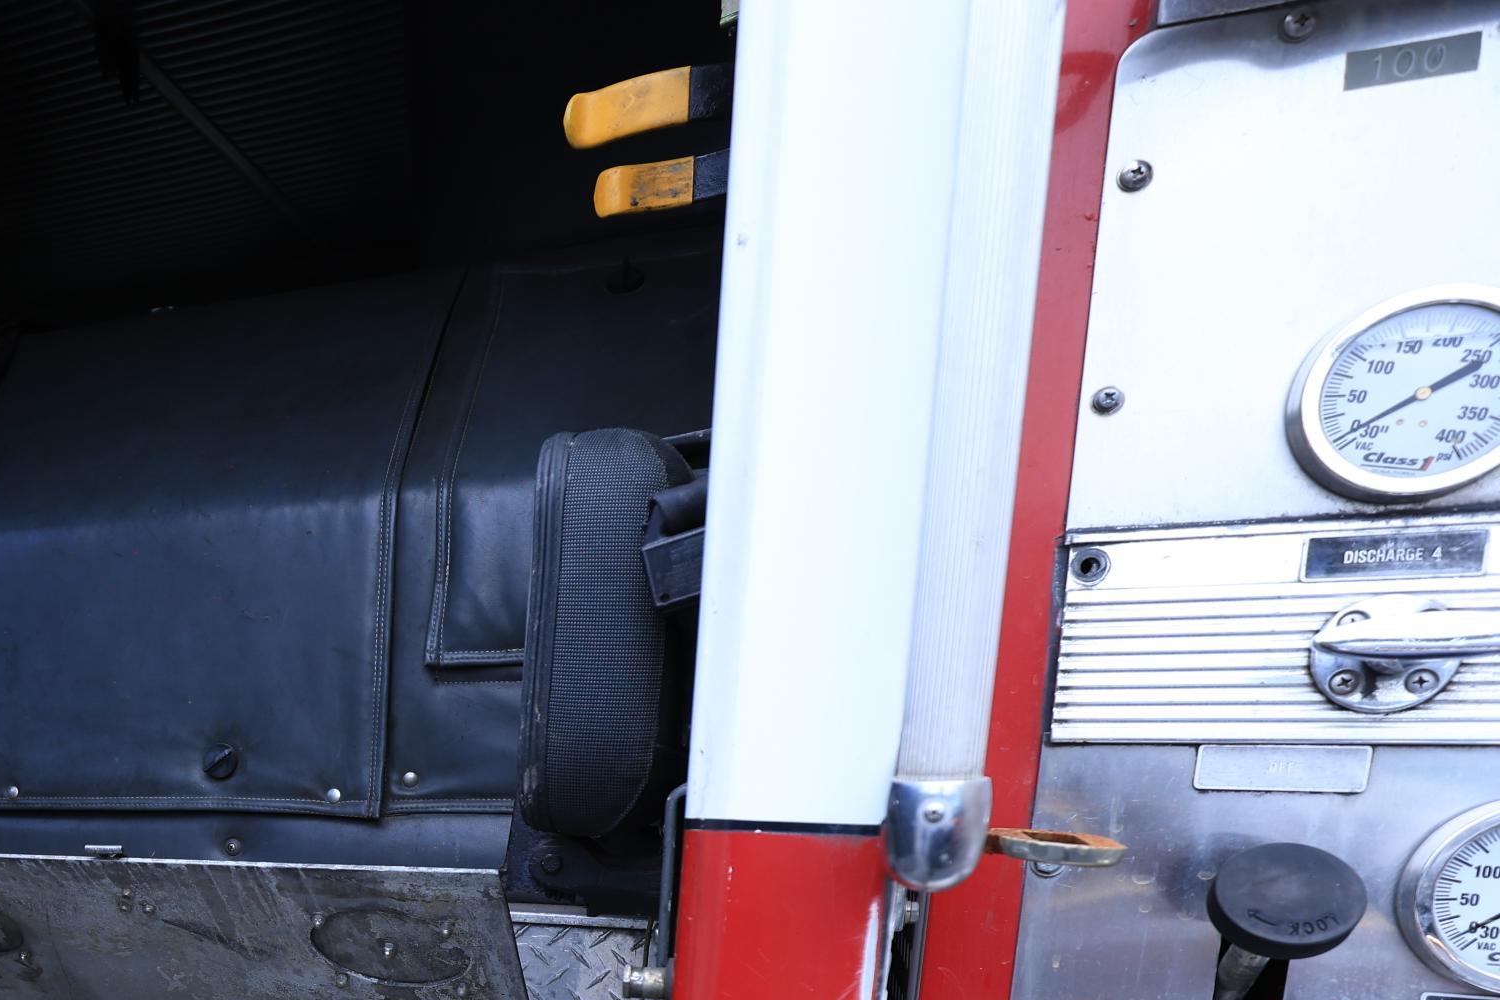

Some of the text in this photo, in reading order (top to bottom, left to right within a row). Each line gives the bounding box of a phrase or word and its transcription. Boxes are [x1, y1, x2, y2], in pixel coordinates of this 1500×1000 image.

[1396, 340, 1423, 354] 150
[1460, 349, 1493, 364] 250
[1367, 360, 1395, 375] 100
[1469, 374, 1500, 389] 300
[1347, 390, 1367, 403] 50
[1457, 406, 1489, 421] 350
[1435, 429, 1466, 444] 400
[1355, 441, 1374, 451] VAC
[1343, 546, 1443, 564] DISCHARGE 4
[1268, 761, 1295, 773] OFF
[1459, 893, 1480, 906] 50
[1289, 912, 1341, 936] LOCK
